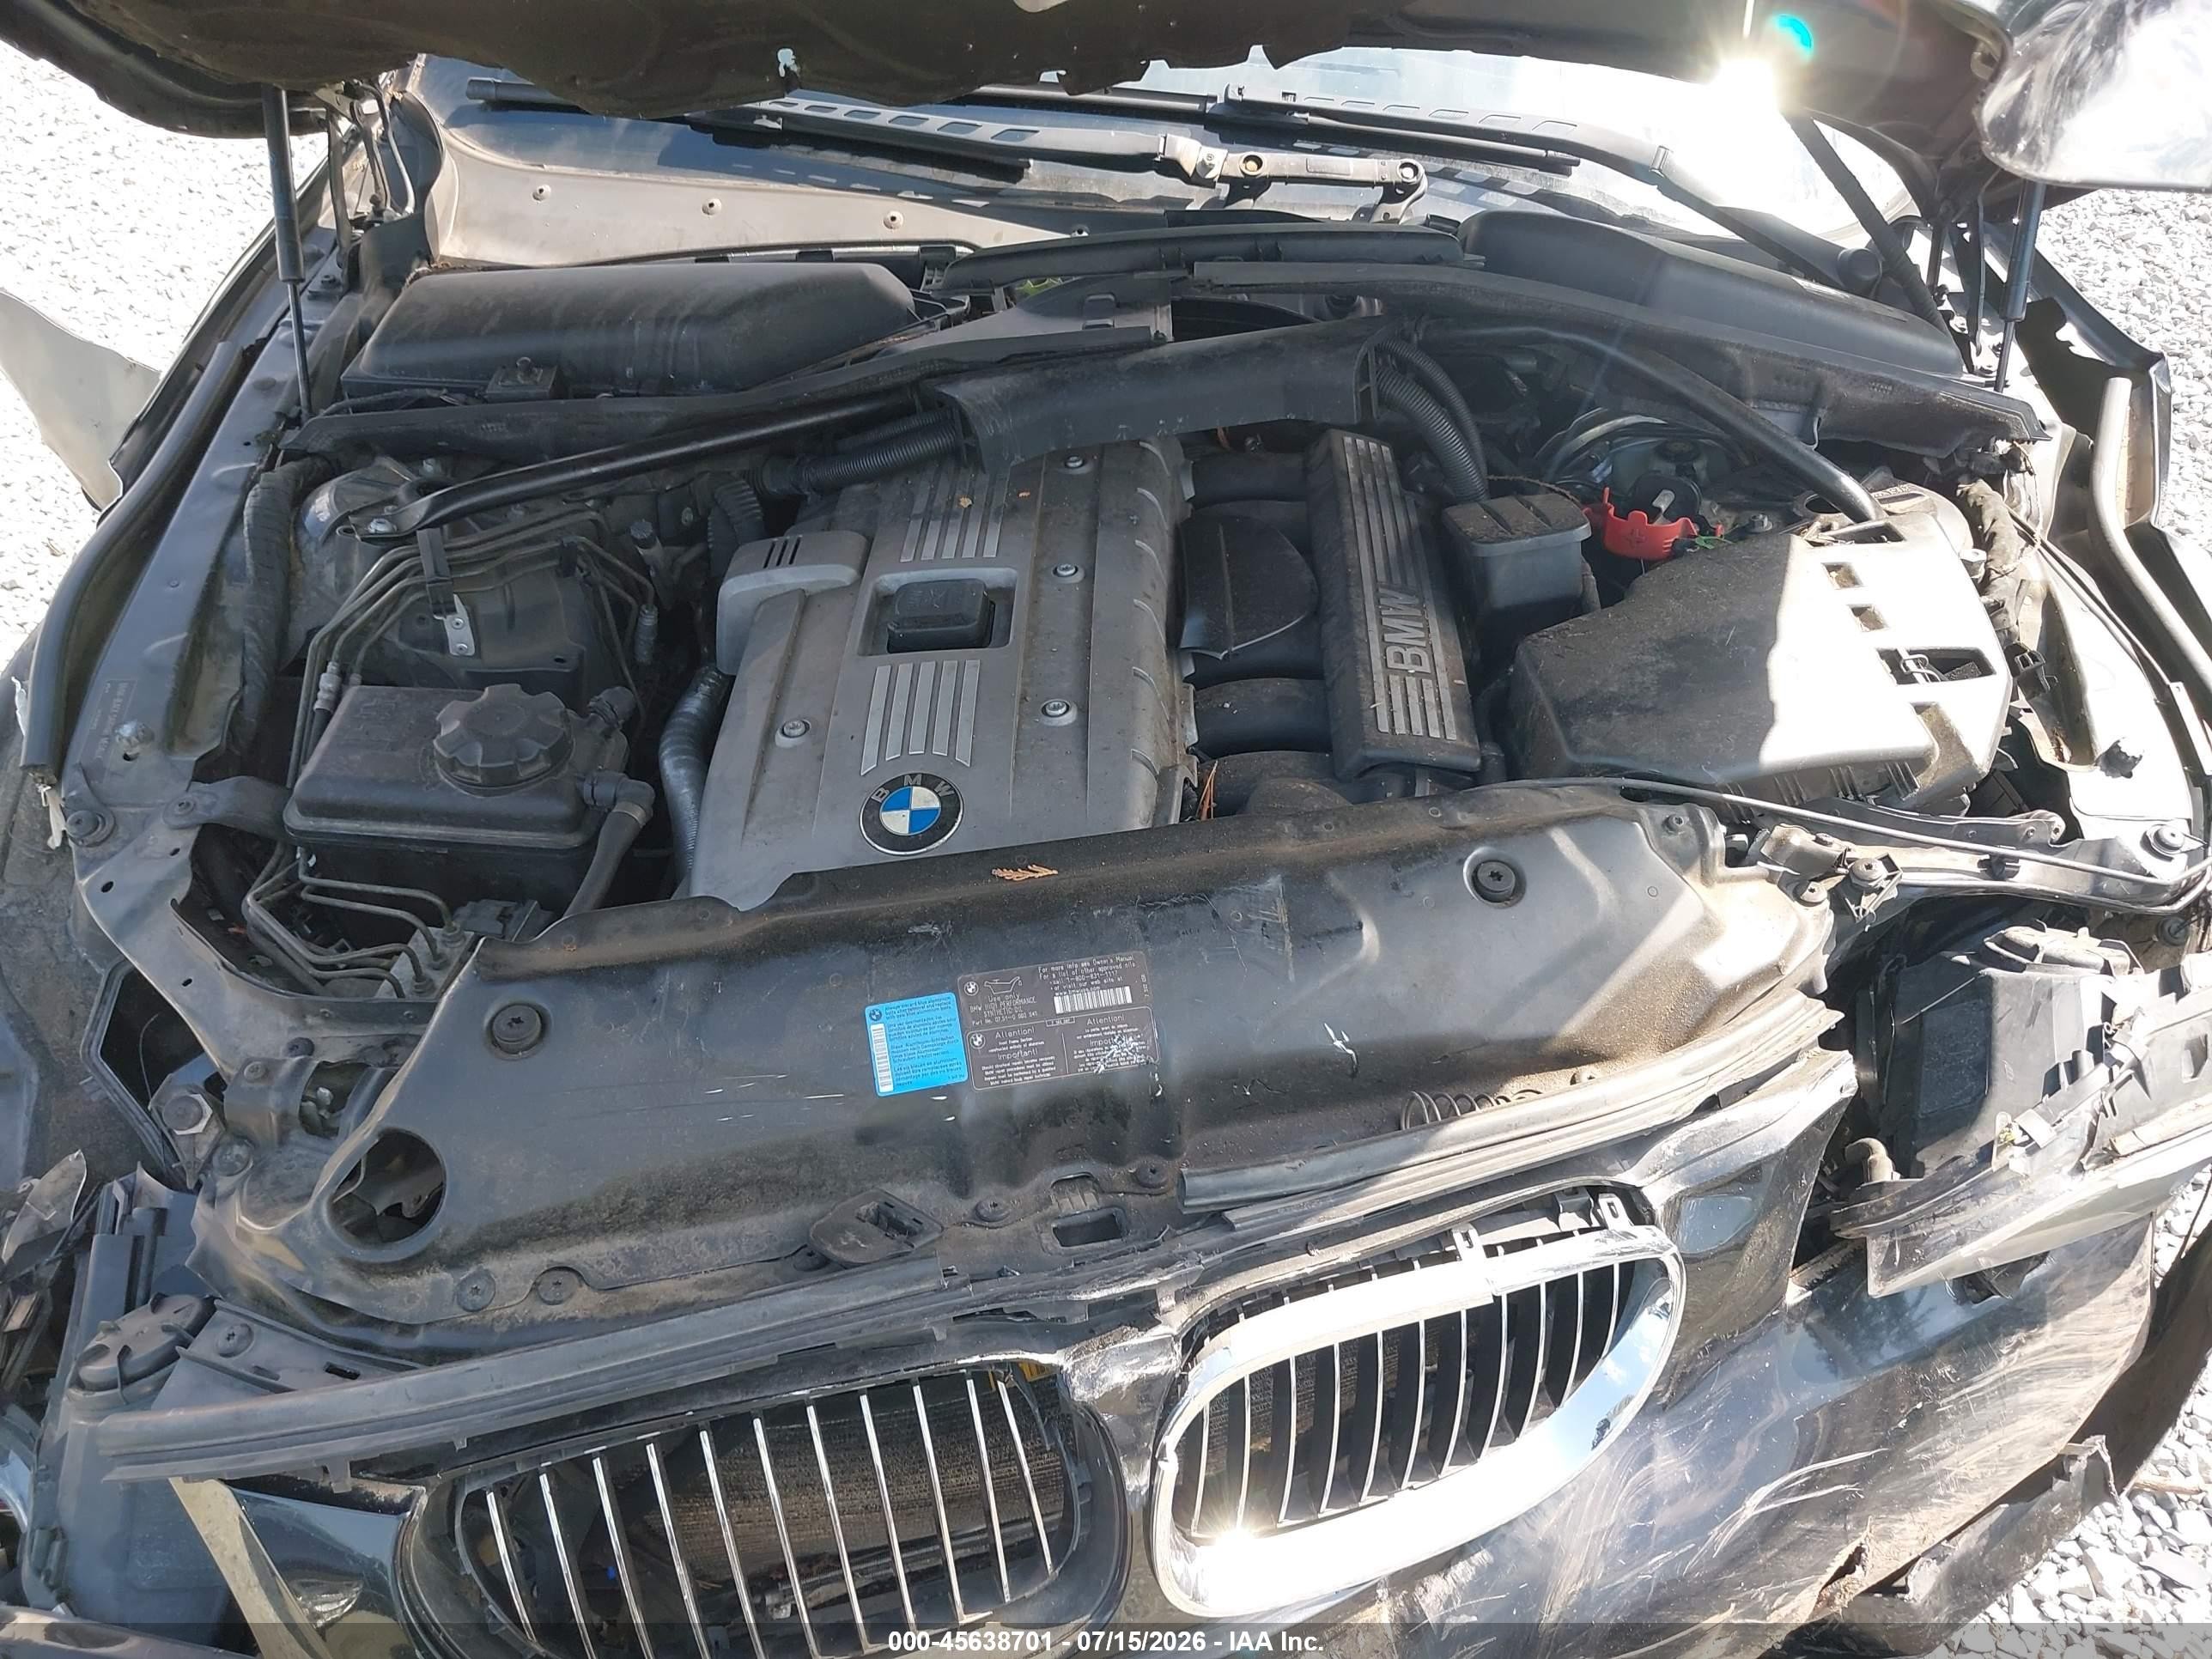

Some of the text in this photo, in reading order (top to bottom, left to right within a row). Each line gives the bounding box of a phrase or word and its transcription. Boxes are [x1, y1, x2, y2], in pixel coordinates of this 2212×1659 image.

[1378, 587, 1431, 674] BMW
[871, 774, 955, 804] BMW
[1086, 1014, 1125, 1025] Attention!
[995, 1026, 1035, 1039] Attention!
